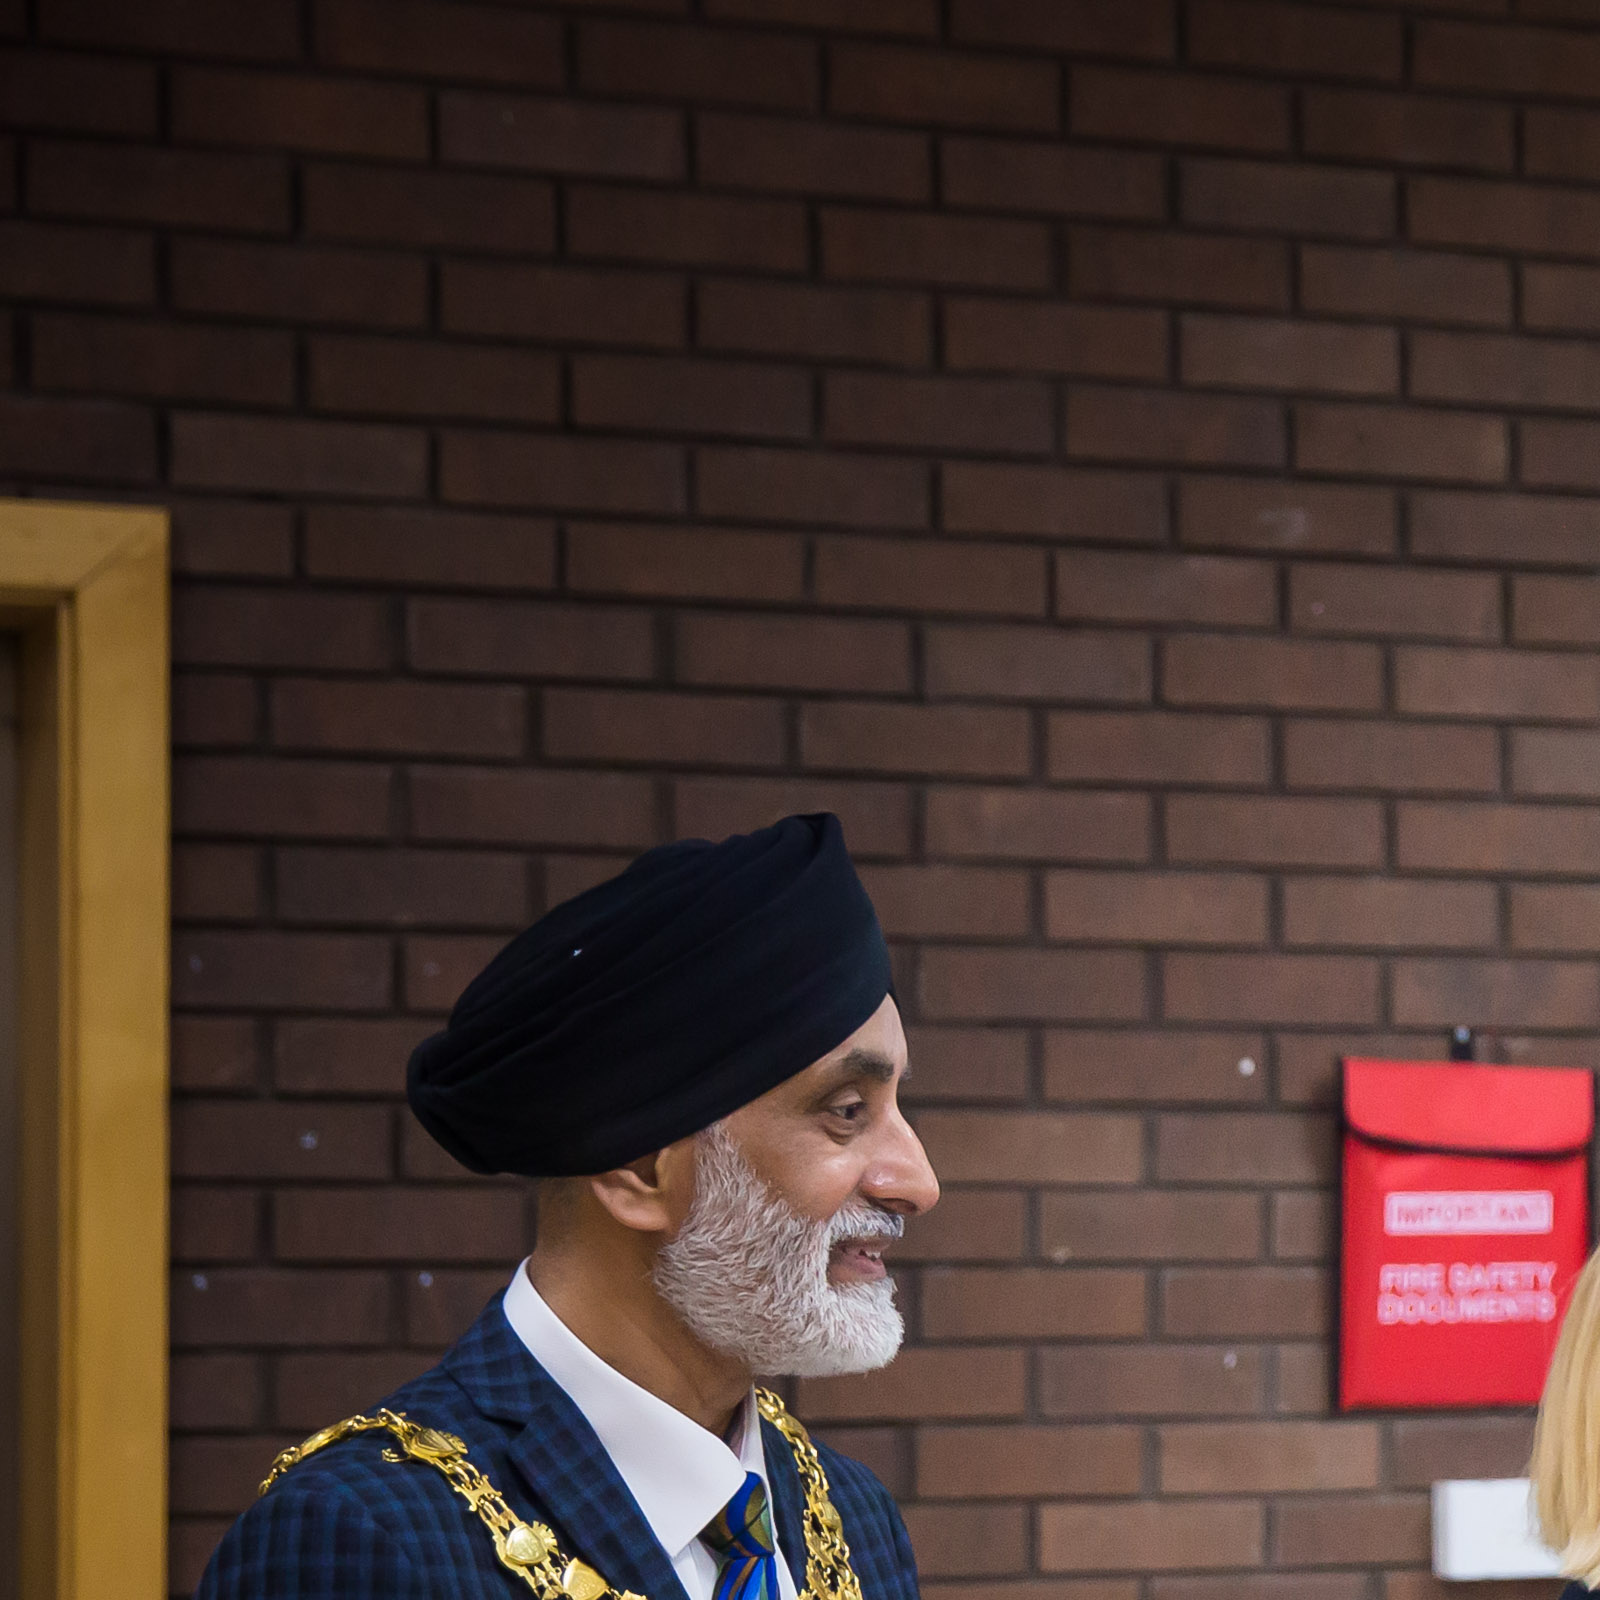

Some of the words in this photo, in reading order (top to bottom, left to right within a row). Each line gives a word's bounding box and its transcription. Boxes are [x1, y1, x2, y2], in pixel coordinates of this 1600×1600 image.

[1381, 1265, 1444, 1292] FIRE
[1450, 1263, 1557, 1291] SAFETY
[1378, 1293, 1555, 1323] DOCUMENTS
